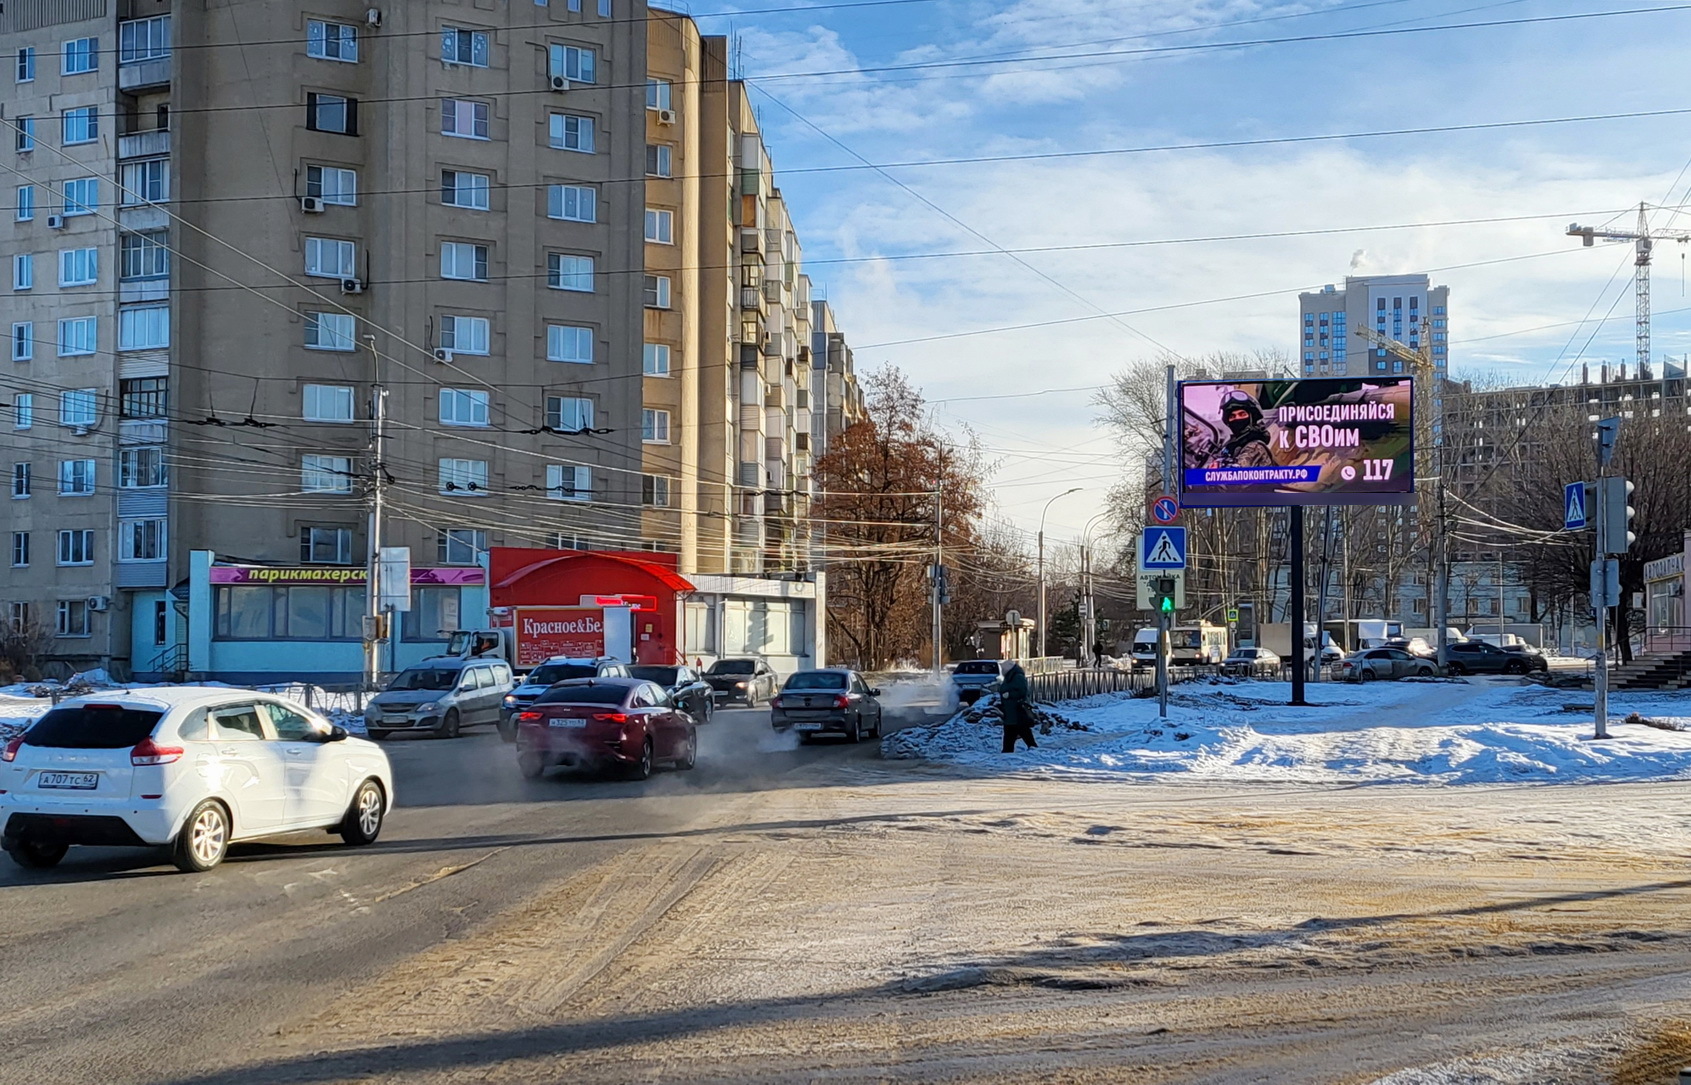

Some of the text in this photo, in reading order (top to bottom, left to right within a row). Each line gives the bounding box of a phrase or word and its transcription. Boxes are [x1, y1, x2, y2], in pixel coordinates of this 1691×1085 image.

[1279, 402, 1395, 423] ПРИСОЕДИНЯЙСЯ
[1205, 469, 1308, 482] СЛУЖБАПОКОНТРАКТУ.РФ
[1363, 459, 1394, 481] 117
